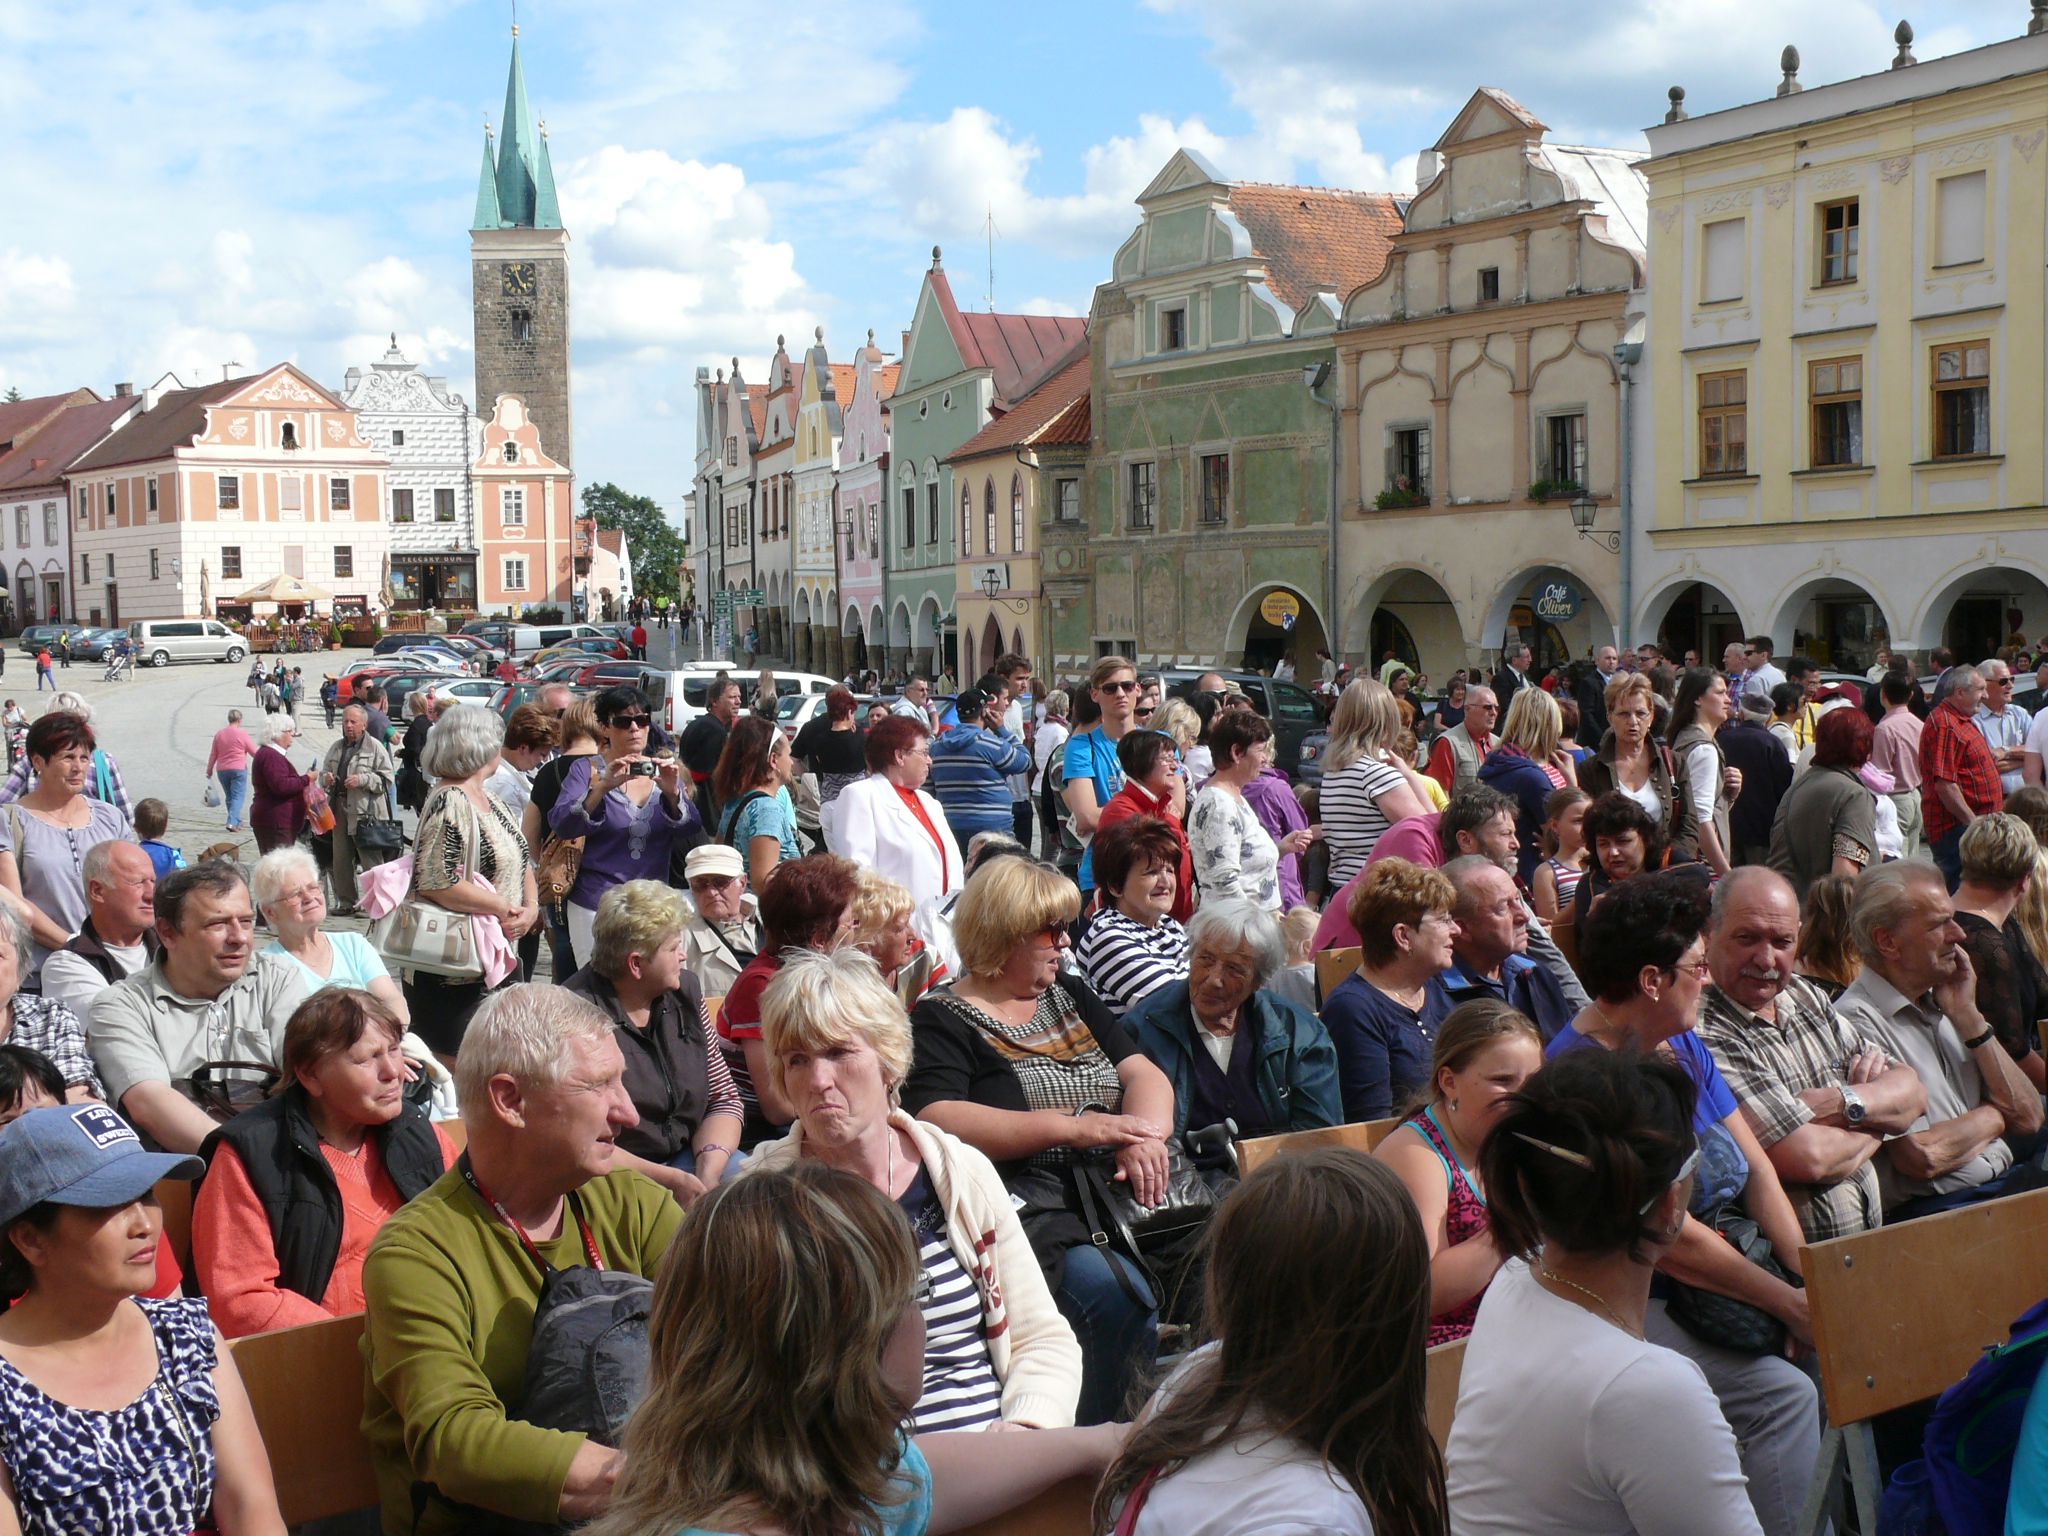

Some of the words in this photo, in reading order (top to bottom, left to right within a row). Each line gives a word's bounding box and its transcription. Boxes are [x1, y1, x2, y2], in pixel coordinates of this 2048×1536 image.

[1545, 584, 1567, 603] Café
[1537, 597, 1572, 615] Oliver
[102, 1118, 117, 1128] IS
